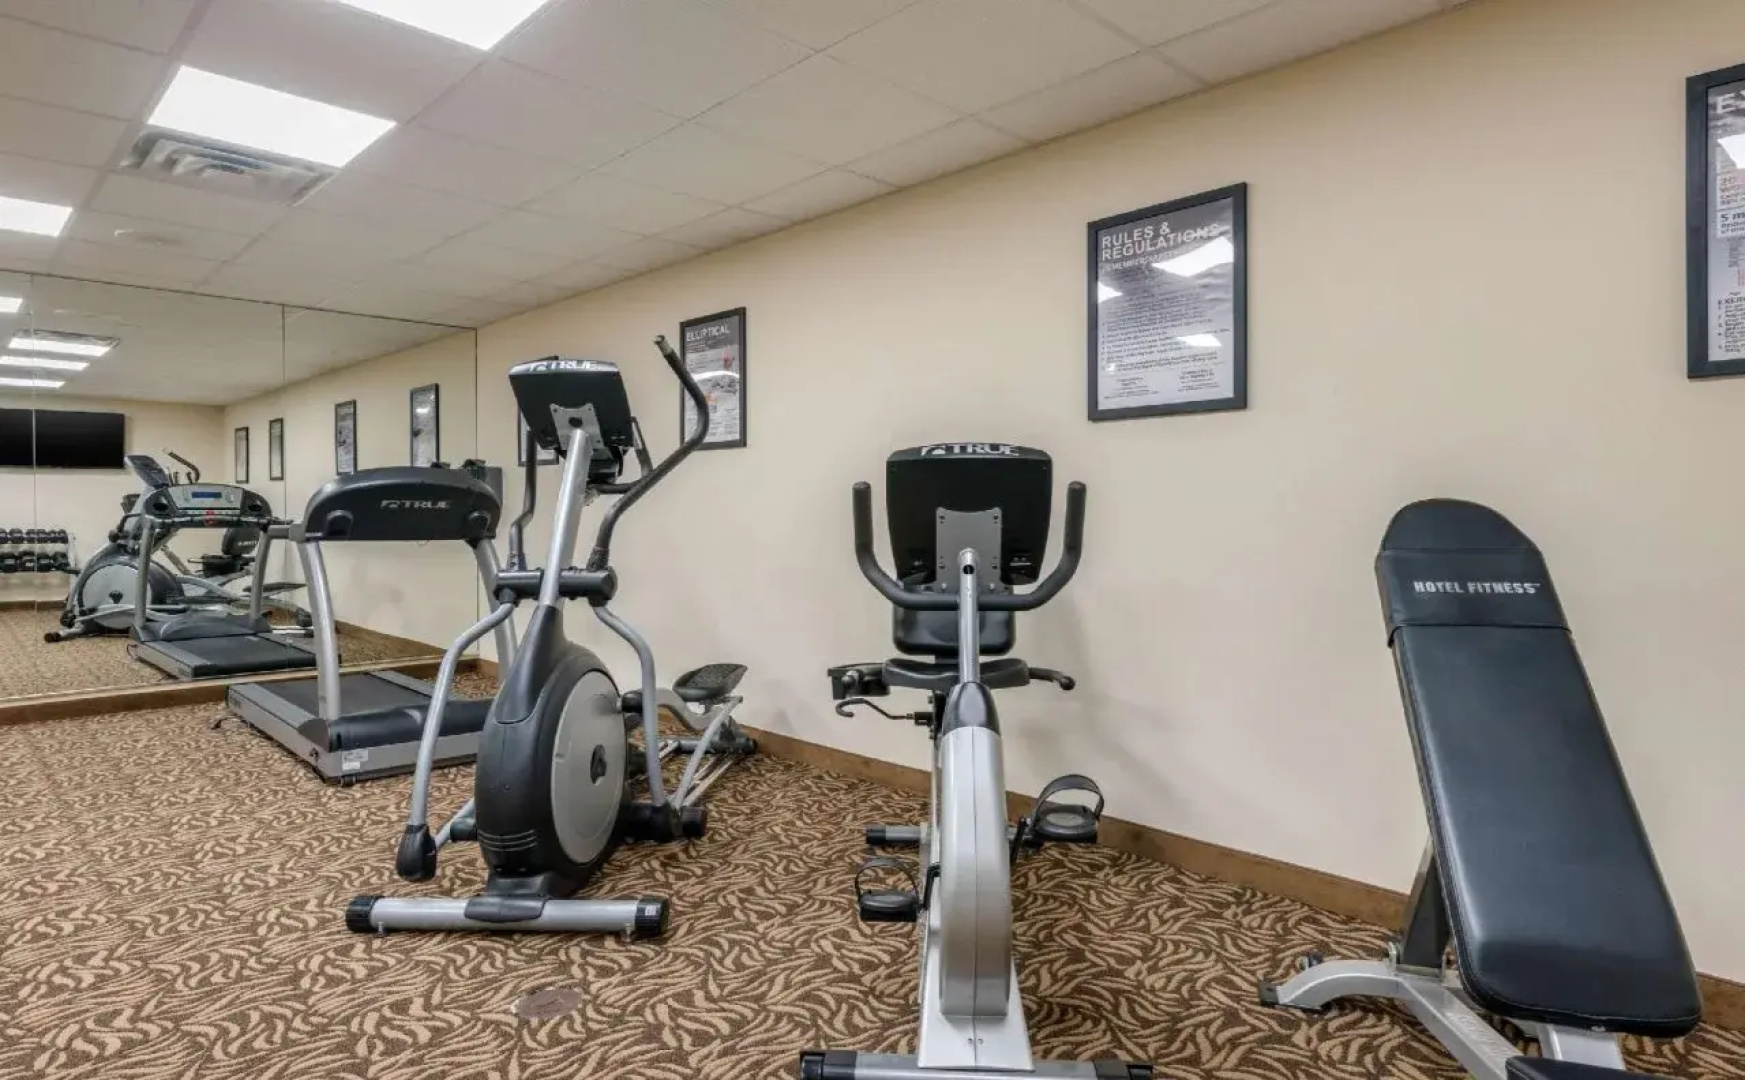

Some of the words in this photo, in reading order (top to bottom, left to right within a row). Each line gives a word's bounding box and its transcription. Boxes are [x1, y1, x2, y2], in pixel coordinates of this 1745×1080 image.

[1102, 226, 1154, 249] RULES
[1160, 221, 1170, 235] &
[1102, 223, 1220, 261] REGULATIONS
[686, 324, 730, 341] ELLIPTICAL
[550, 360, 598, 371] TRUE
[949, 443, 1019, 457] TRUE
[402, 499, 451, 509] TRUE
[1413, 581, 1464, 593] HOTEL
[1467, 582, 1537, 594] FITNESS
